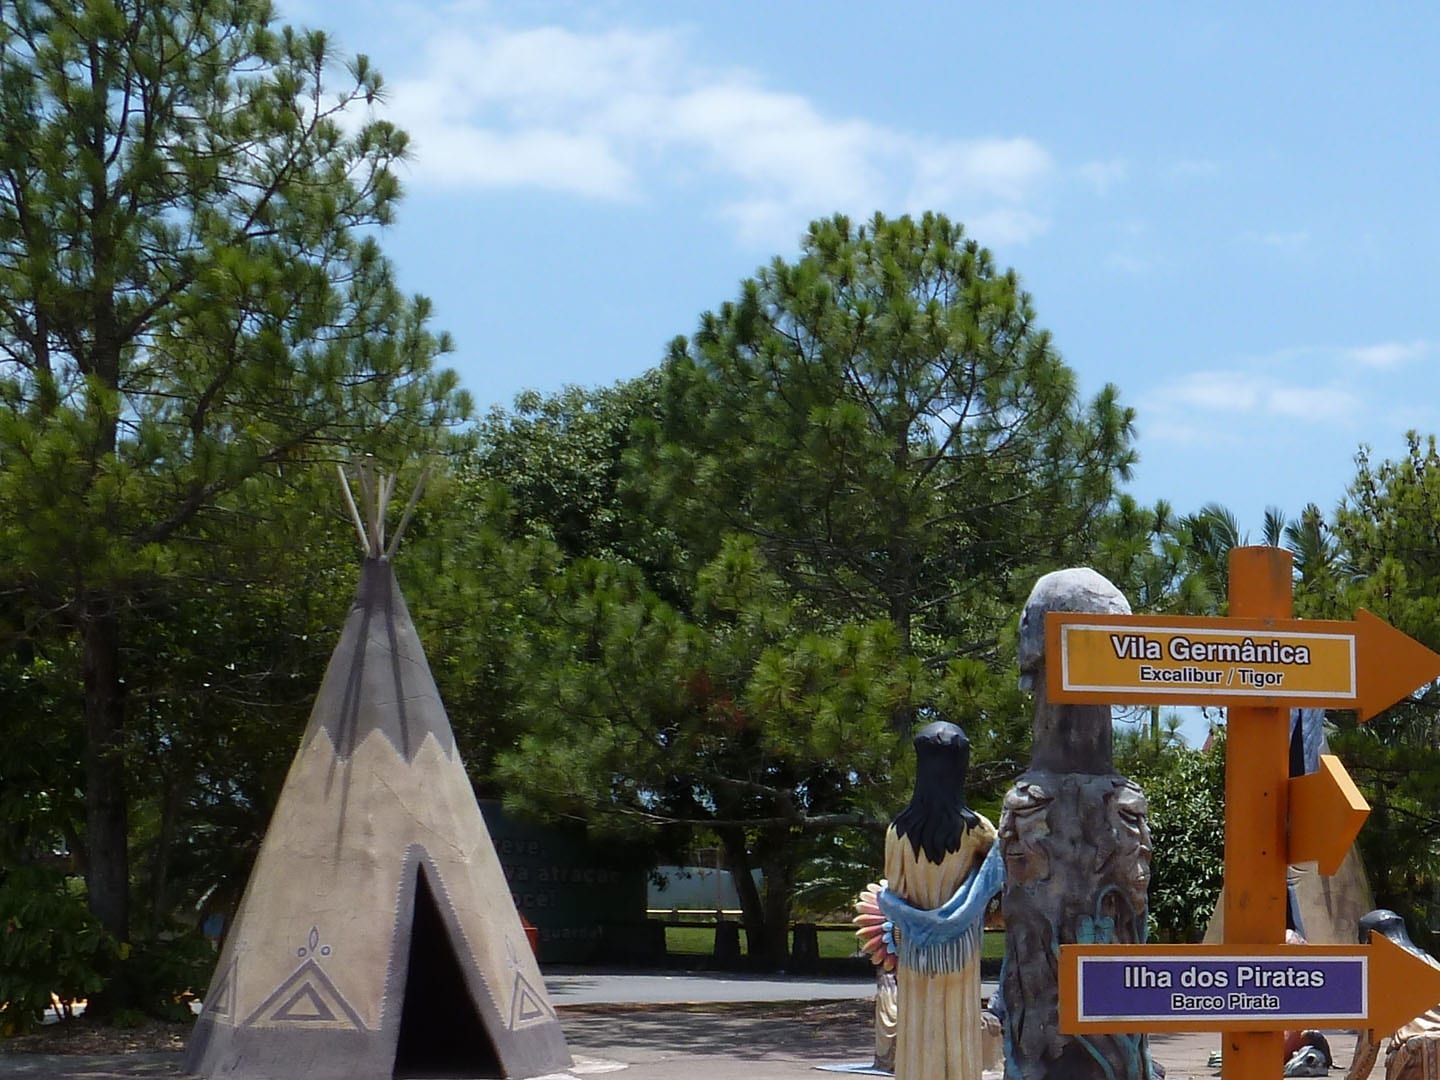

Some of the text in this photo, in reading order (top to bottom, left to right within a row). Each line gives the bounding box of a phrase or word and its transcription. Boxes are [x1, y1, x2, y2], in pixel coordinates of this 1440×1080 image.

[1111, 635, 1310, 665] Vila Germânica
[1140, 667, 1222, 684] Excalibur
[1238, 668, 1283, 688] Tigor
[1124, 966, 1324, 988] Ilha dos Piratas
[1171, 994, 1278, 1010] Barco Pirata
